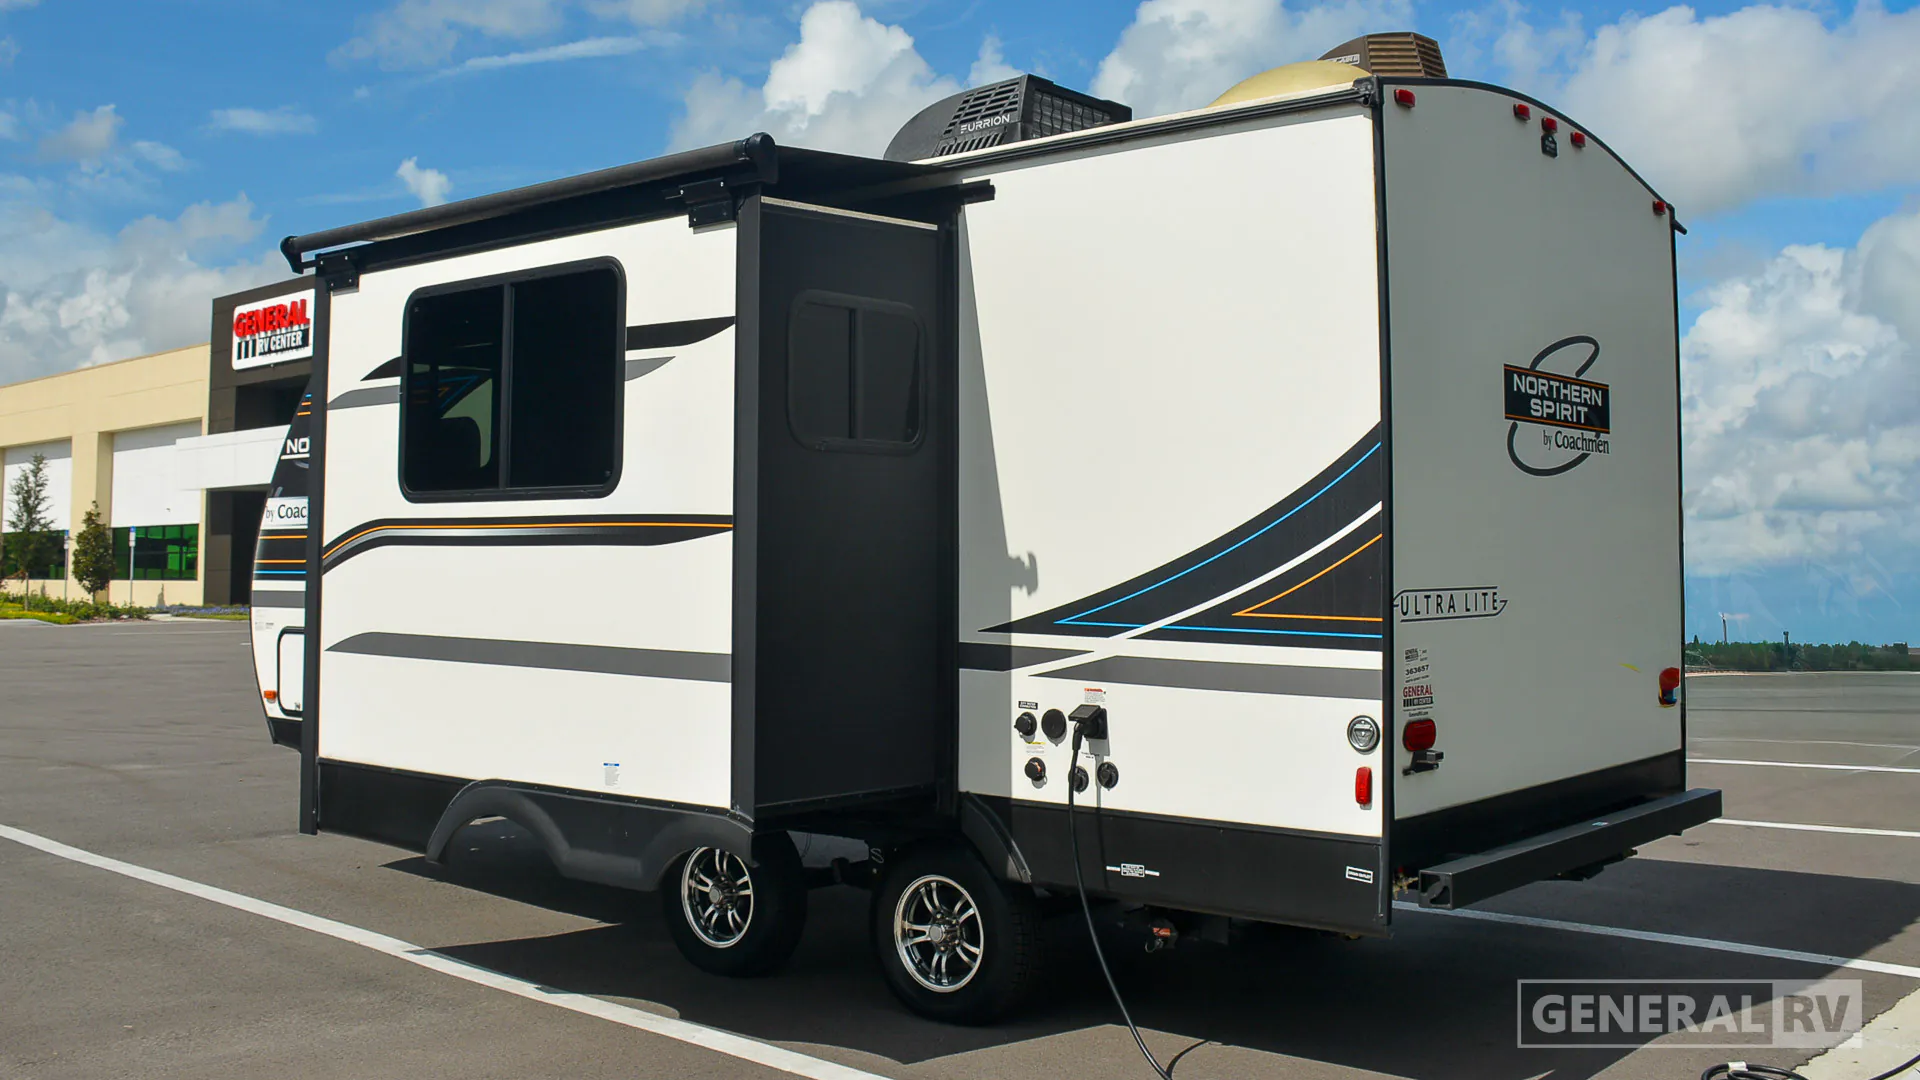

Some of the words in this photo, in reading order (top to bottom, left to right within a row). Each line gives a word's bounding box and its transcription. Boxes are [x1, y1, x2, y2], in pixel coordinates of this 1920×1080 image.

[961, 114, 1010, 134] FURRION
[234, 299, 311, 338] GENERAL
[259, 338, 270, 353] RV
[270, 331, 303, 351] CENTER
[1513, 373, 1602, 407] NORTHERN
[1530, 398, 1588, 423] SPIRIT
[286, 437, 310, 454] NO
[1543, 430, 1552, 450] by
[1554, 430, 1610, 454] Coachmen
[265, 506, 274, 522] by
[277, 504, 308, 519] Coac
[1400, 593, 1456, 616] ULTRA
[1465, 591, 1498, 612] LITE
[1403, 684, 1433, 698] GENERAL
